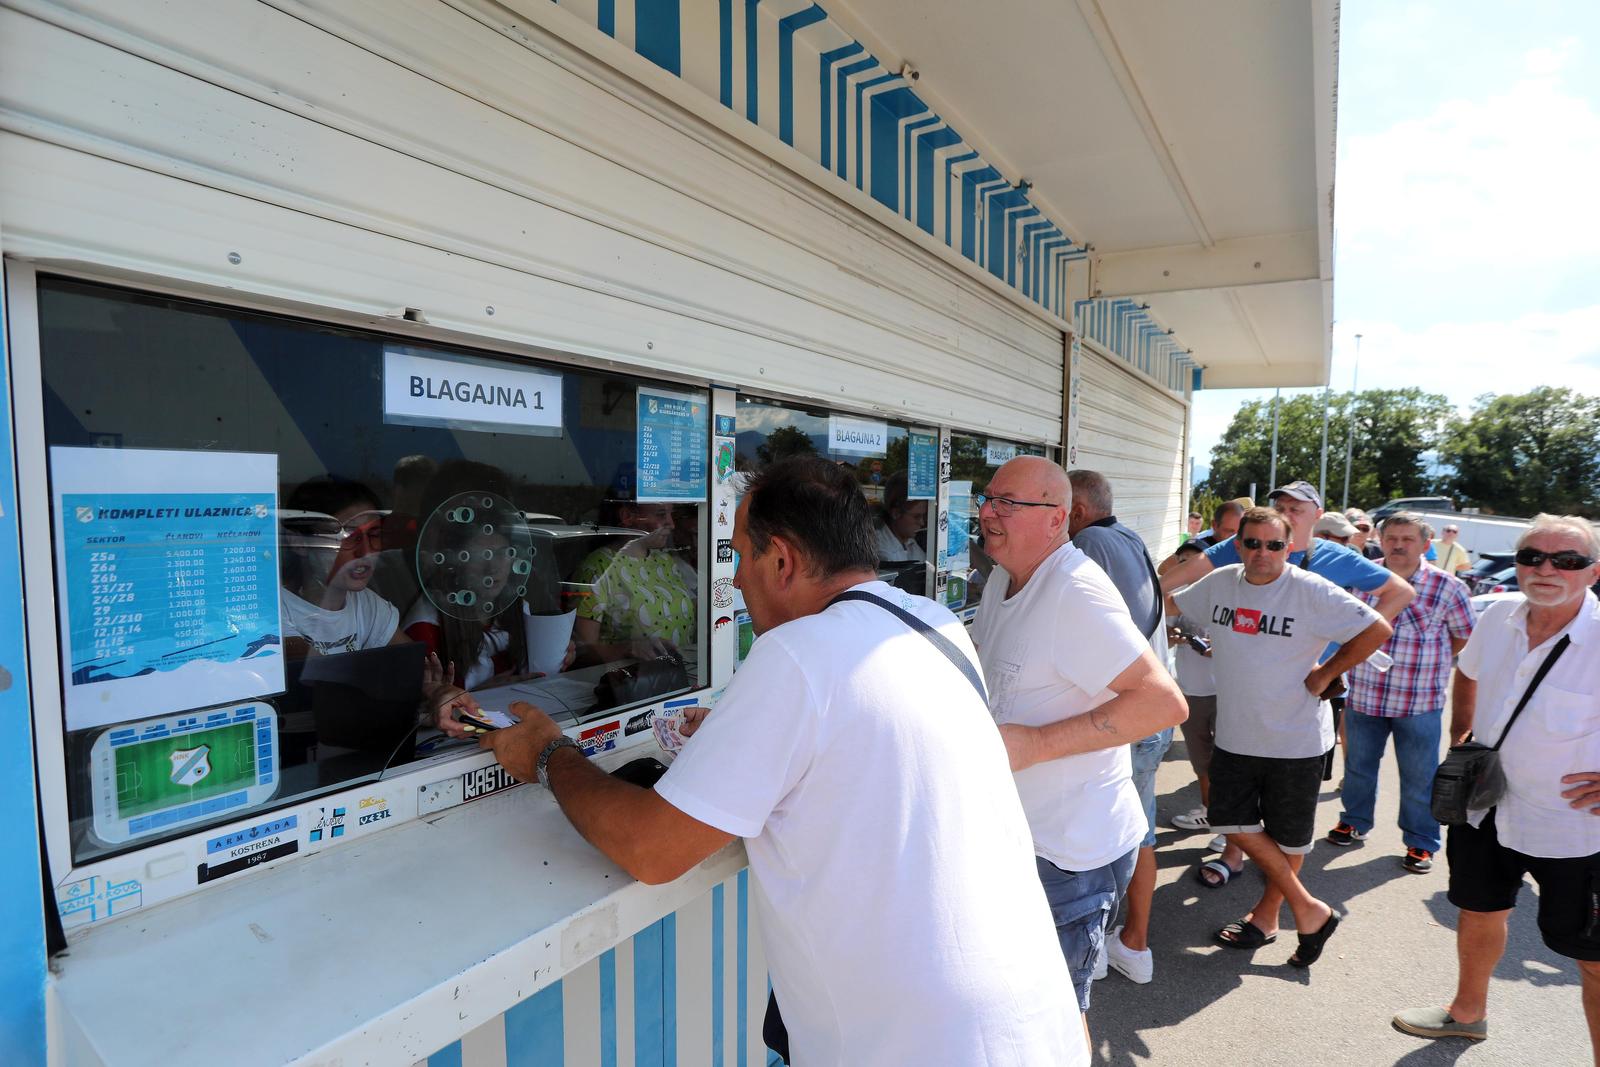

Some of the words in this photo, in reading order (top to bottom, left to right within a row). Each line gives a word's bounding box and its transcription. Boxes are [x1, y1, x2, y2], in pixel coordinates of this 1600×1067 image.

[410, 375, 527, 409] BLAGAJNA
[533, 391, 544, 410] 1
[836, 430, 875, 445] BLAGAJNA
[876, 436, 881, 446] 2
[98, 507, 180, 520] KOMPLETI
[184, 506, 254, 518] ULAZNICA
[86, 535, 126, 544] SEKTOR
[90, 552, 116, 561] Z5a
[224, 546, 256, 554] 7.200.00
[90, 563, 116, 573] Z6a
[224, 556, 256, 564] 3.240.00
[91, 573, 117, 584] Z6b
[224, 565, 257, 574] 2.600.00
[91, 582, 134, 594] Z3/Z7
[224, 575, 257, 583] 2.700.00
[92, 593, 135, 605] Z4/Z8
[225, 584, 257, 593] 2.025.00
[93, 606, 111, 616] Z9
[225, 594, 257, 602] 1.620.00
[93, 613, 143, 626] Z2/Z10
[95, 645, 135, 659] S1-S5
[230, 836, 281, 858] KOSTRENA
[246, 852, 267, 865] 1987
